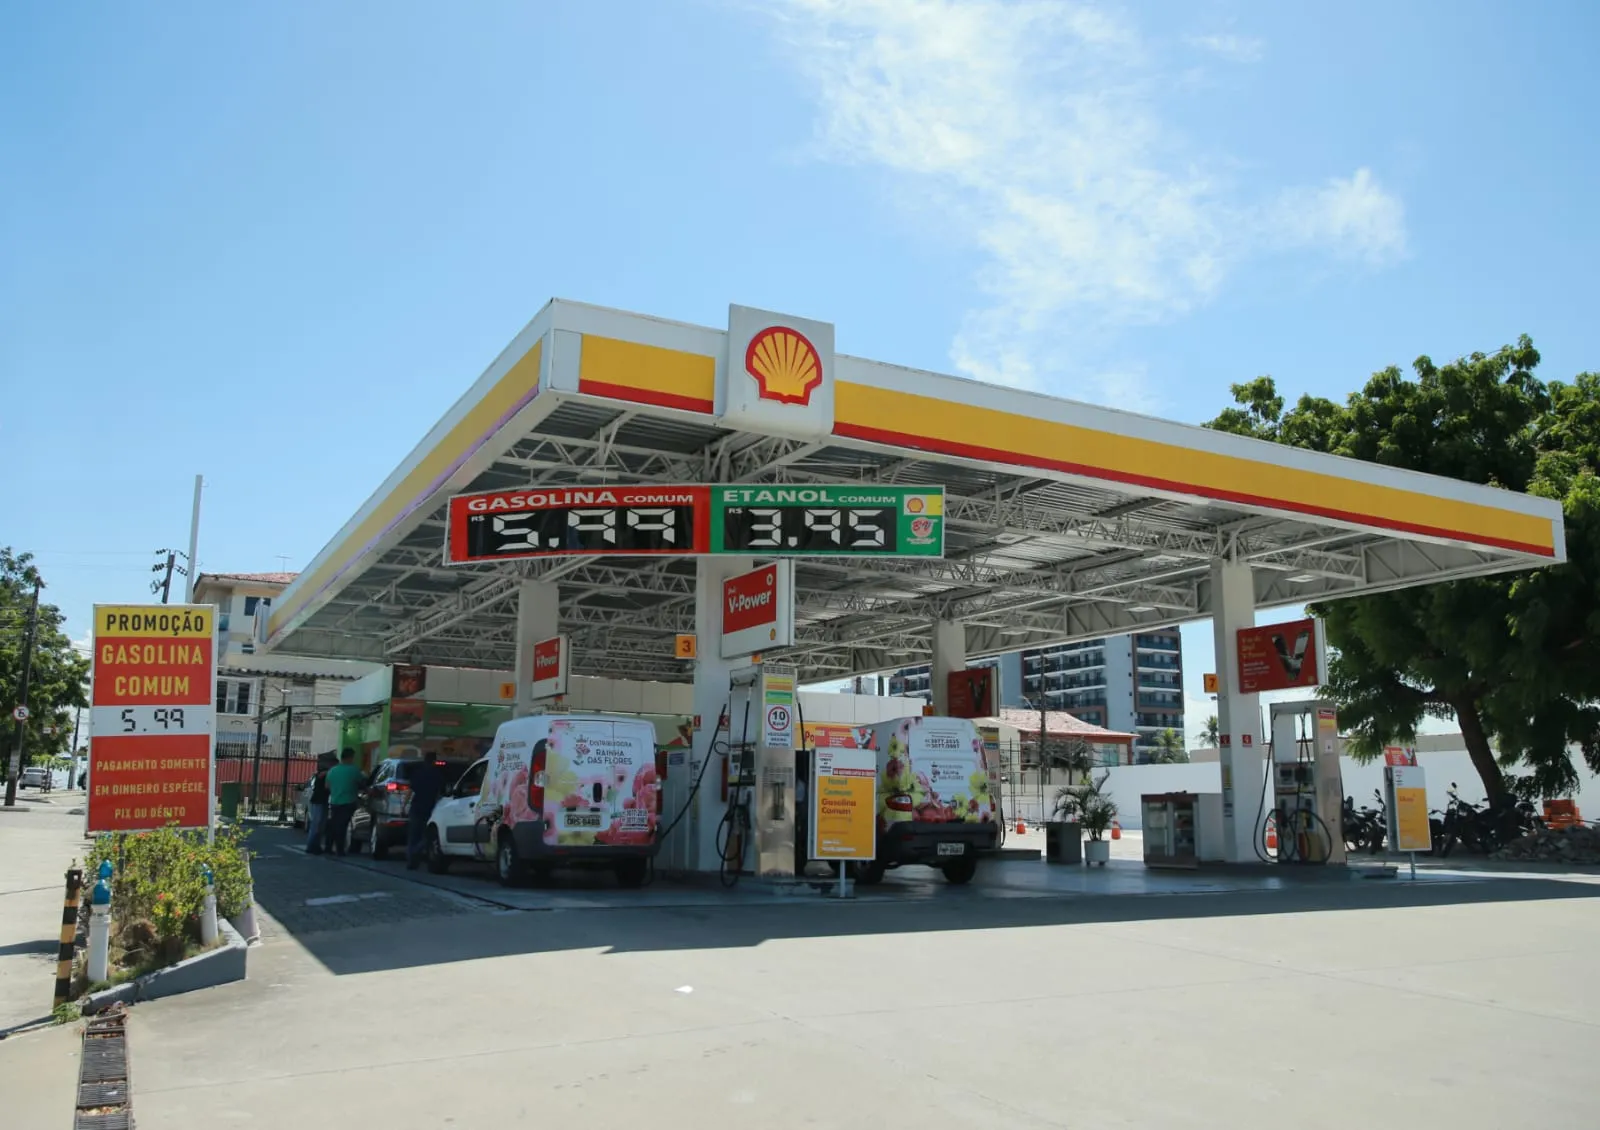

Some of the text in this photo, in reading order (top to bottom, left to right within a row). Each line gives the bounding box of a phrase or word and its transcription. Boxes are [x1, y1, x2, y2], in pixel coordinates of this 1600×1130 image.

[468, 491, 693, 511] GASOLINA COMUM
[723, 490, 834, 503] ETANOL
[492, 508, 676, 550] 5.99
[748, 509, 885, 547] 3.95
[728, 590, 772, 614] V-Power
[106, 610, 204, 636] PROMOÇÃO
[682, 640, 691, 653] 3
[102, 644, 204, 665] GASOLINA
[114, 676, 189, 696] COMUM
[1208, 677, 1216, 688] 7
[121, 709, 184, 732] 5.99
[772, 711, 786, 720] 10
[596, 748, 625, 756] RAINHA
[96, 758, 206, 772] PAGAMENTO SOMENTE
[587, 756, 633, 765] DAS FLORES
[95, 784, 109, 796] EM
[112, 783, 159, 795] DINHEIRO
[115, 804, 186, 819] PIX OU DÉBITO
